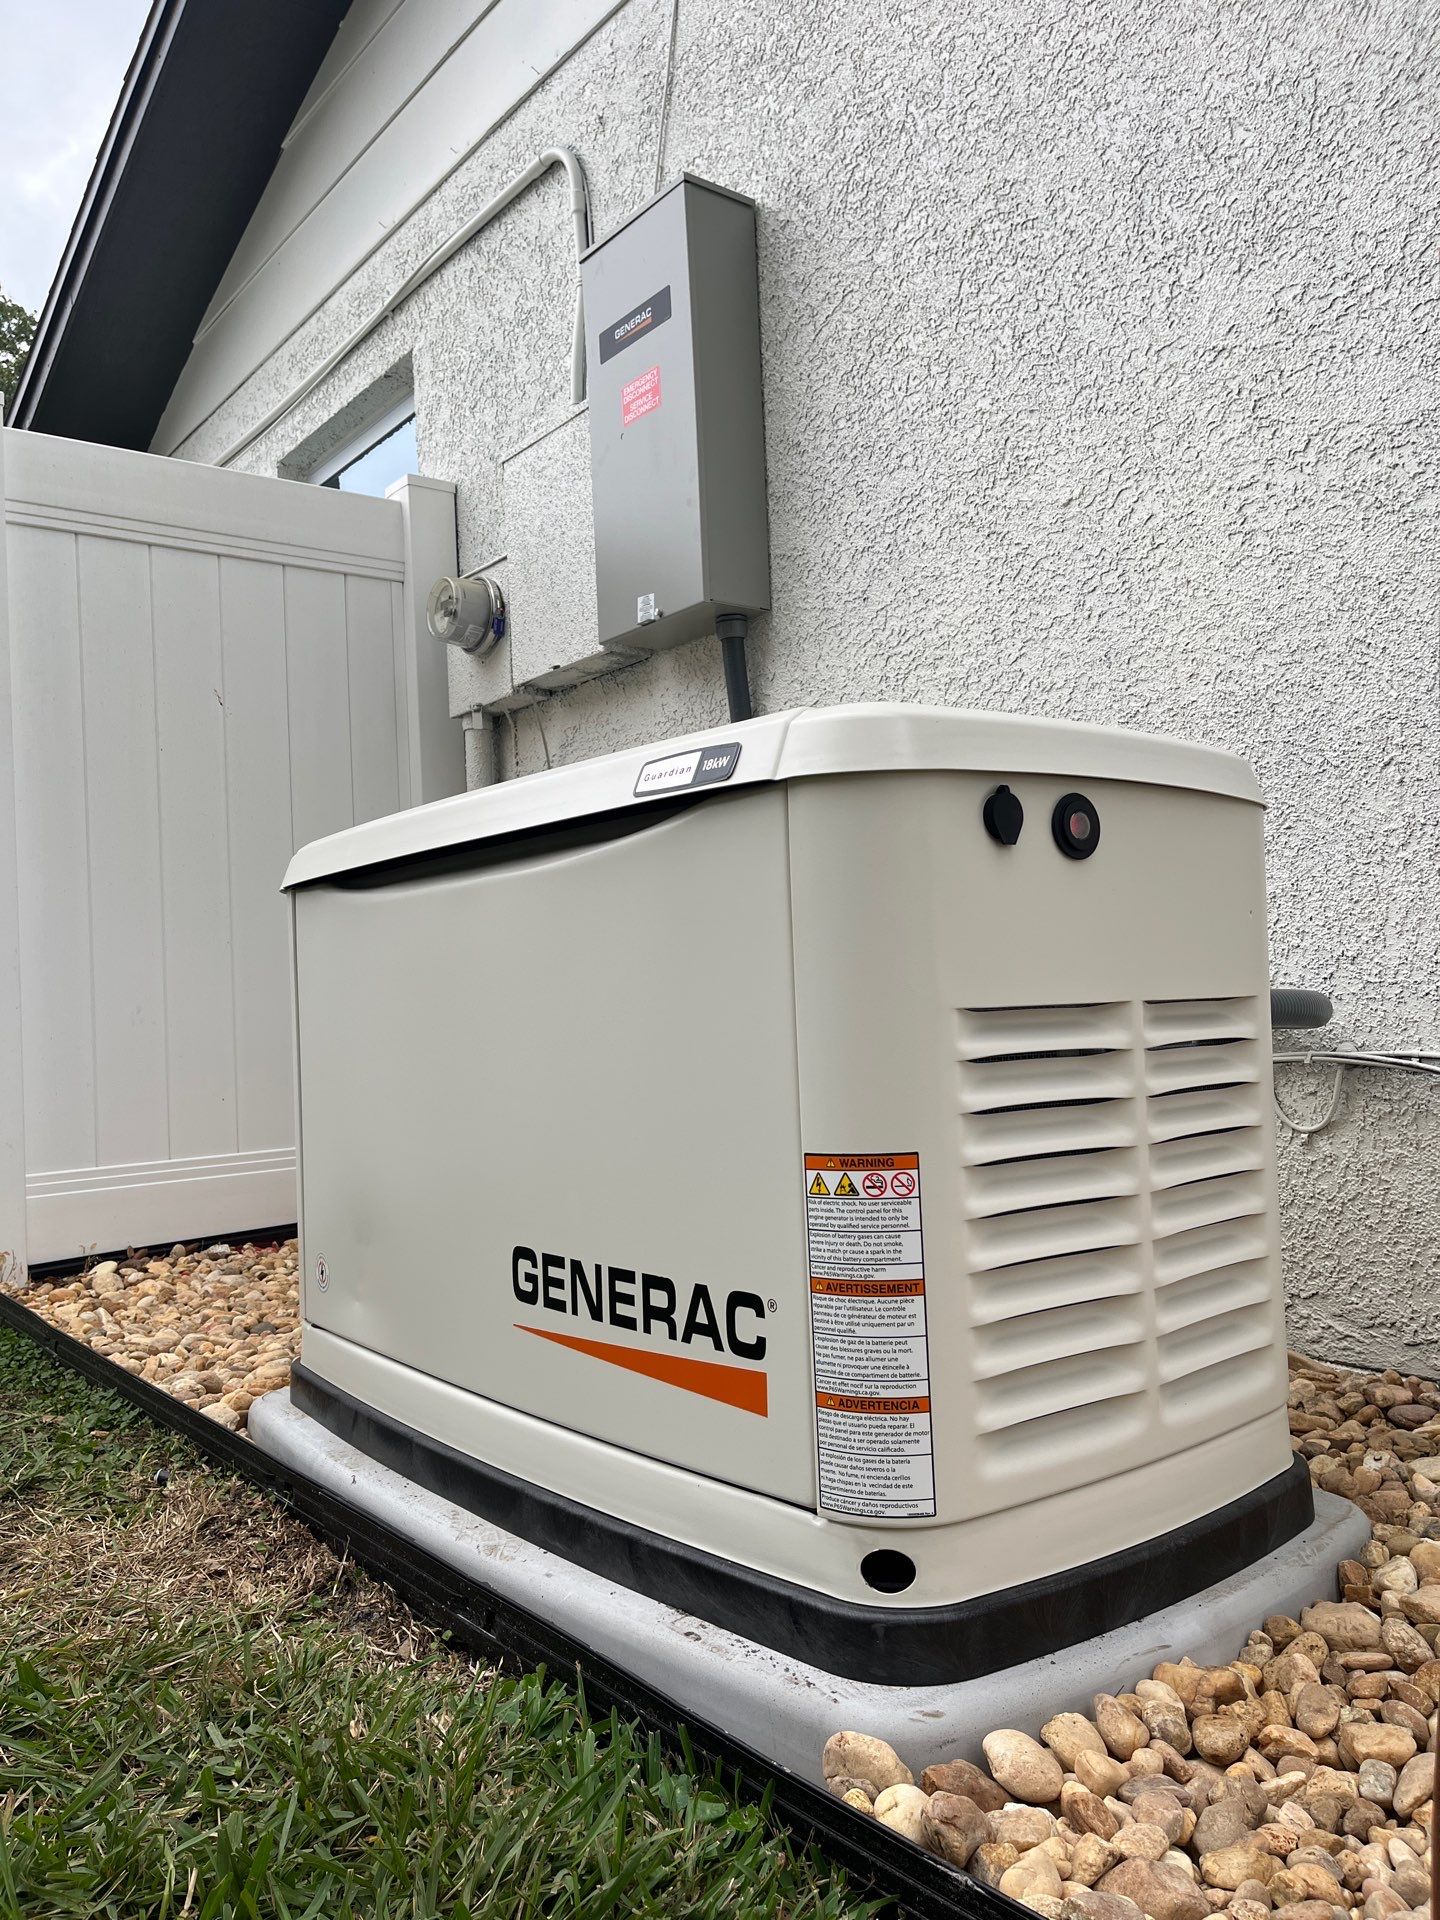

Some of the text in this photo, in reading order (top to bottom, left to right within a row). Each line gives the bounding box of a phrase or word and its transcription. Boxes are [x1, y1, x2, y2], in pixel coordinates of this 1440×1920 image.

[614, 307, 652, 340] GENERAC
[624, 368, 658, 396] EMERGENCY
[624, 376, 658, 405] DISCONNECT
[624, 396, 659, 424] DISCONNECT
[630, 392, 653, 412] SERVICE
[644, 755, 731, 782] Guardian 18kW
[839, 1158, 894, 1168] WARNING
[826, 1283, 919, 1293] AVERTISSEMENT
[851, 1371, 889, 1380] compartiment
[838, 1399, 920, 1410] ADVERTENCIA
[866, 1438, 889, 1446] operado
